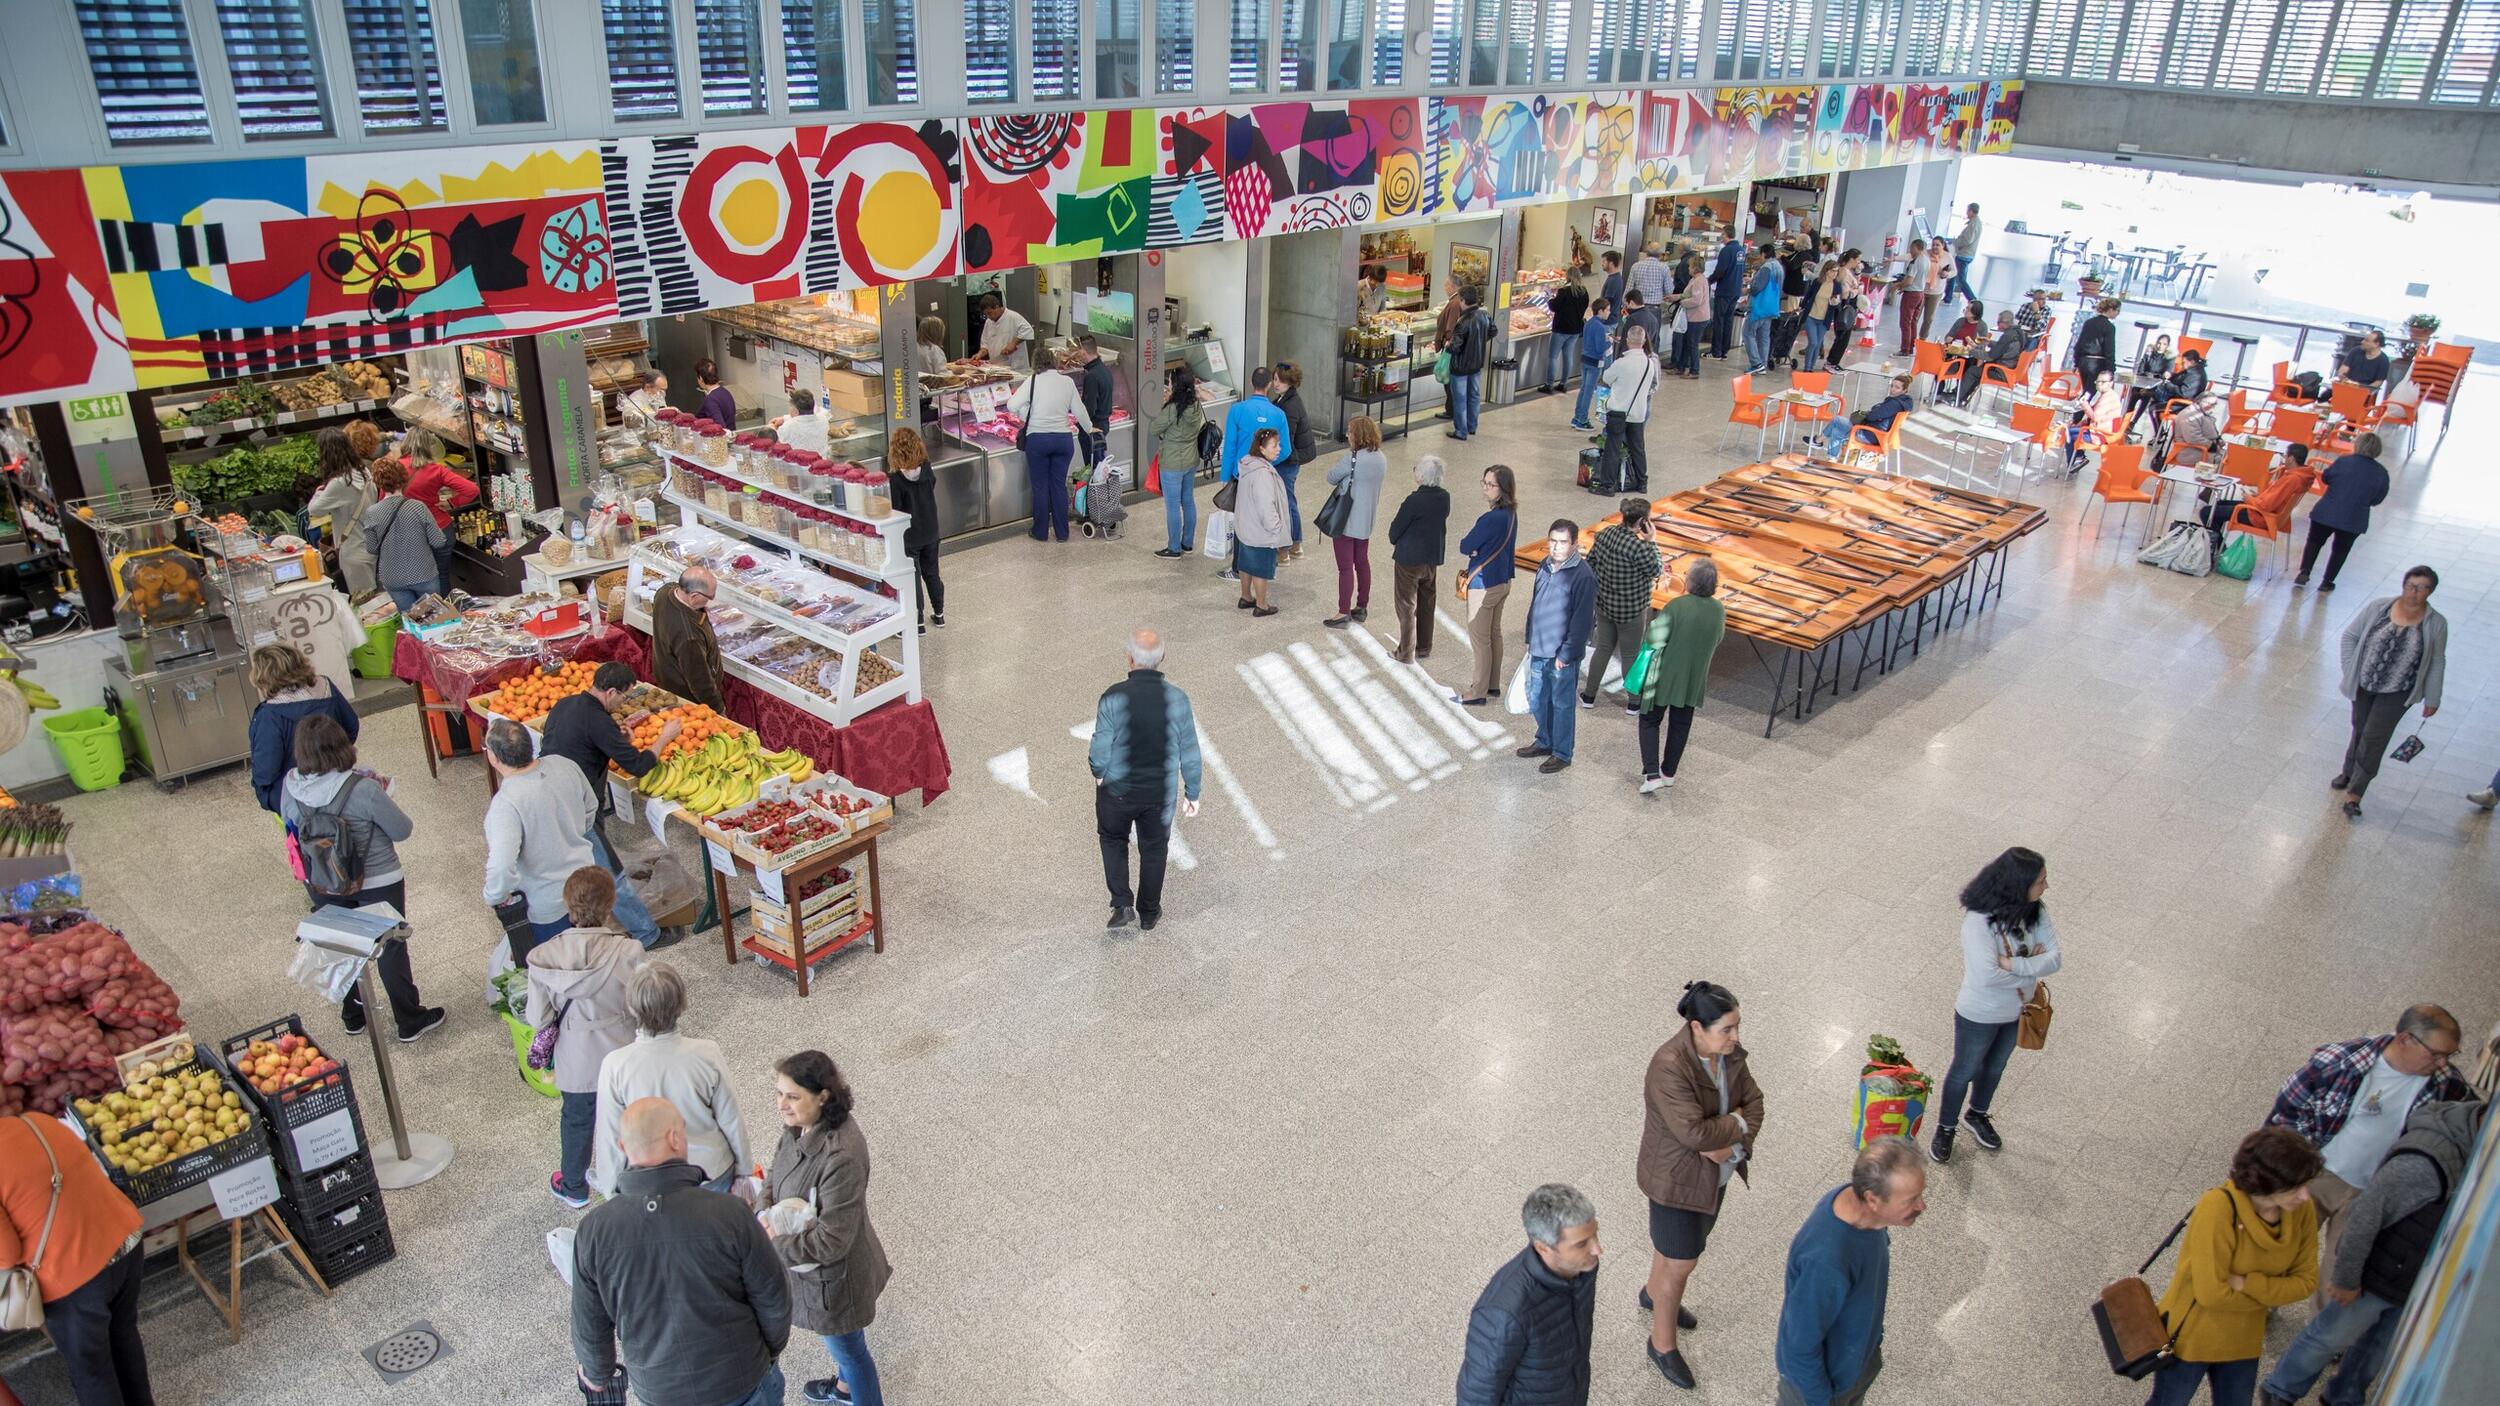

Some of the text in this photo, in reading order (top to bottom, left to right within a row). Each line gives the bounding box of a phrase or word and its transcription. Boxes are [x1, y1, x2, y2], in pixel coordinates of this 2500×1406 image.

[1144, 339, 1152, 372] Talho
[558, 377, 573, 435] Legumes
[893, 368, 904, 421] Padaria
[574, 406, 592, 484] HORTA CARAMELA
[566, 448, 579, 488] Frutas
[777, 847, 807, 863] AVELINO
[810, 832, 845, 850] SALVADOR
[803, 901, 857, 931] ELINO SALVADOR
[226, 1175, 261, 1194] Promoção
